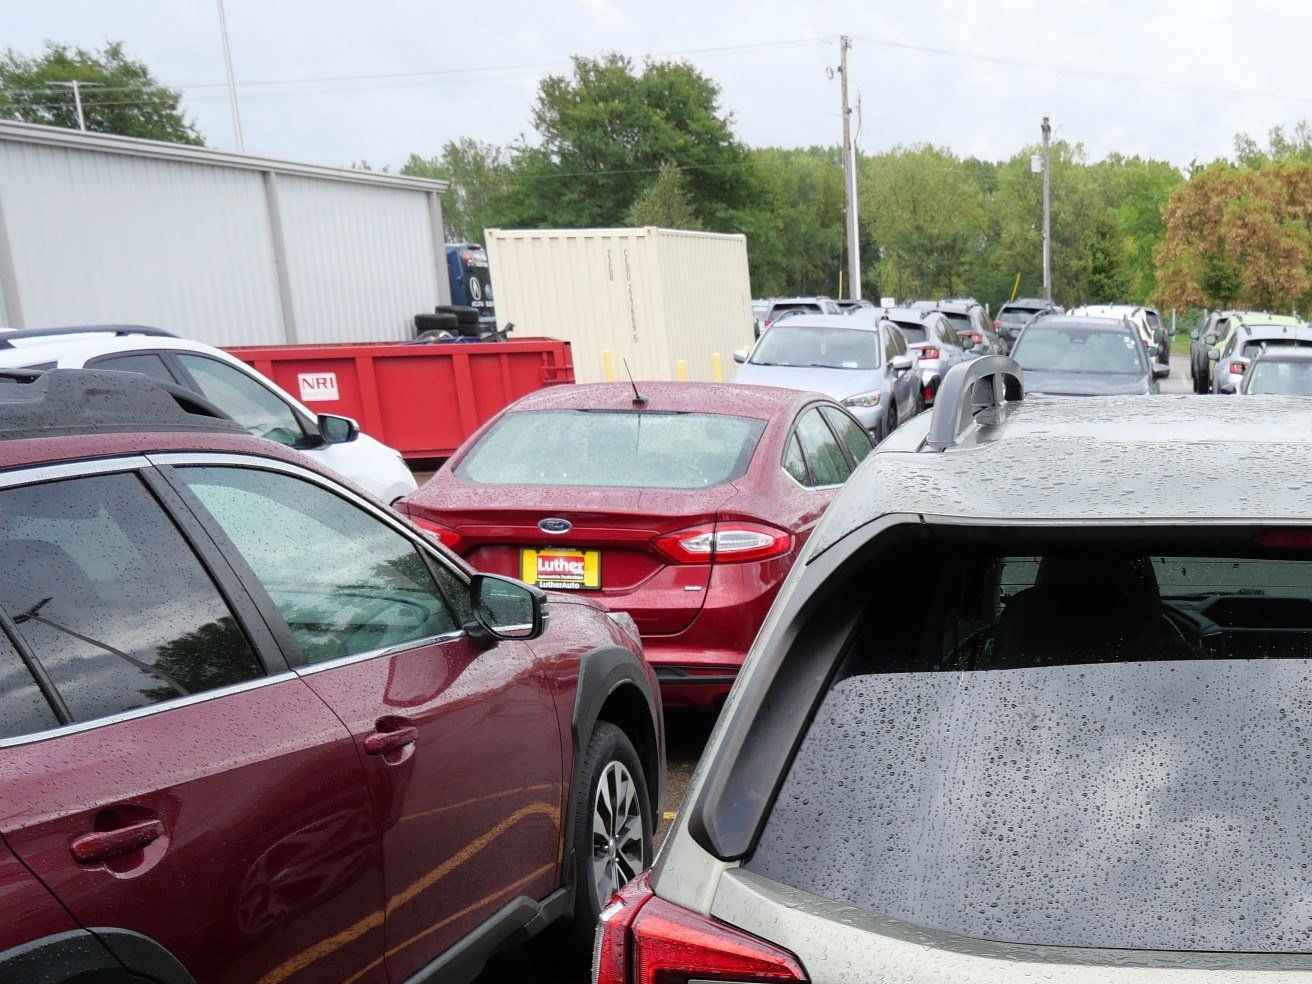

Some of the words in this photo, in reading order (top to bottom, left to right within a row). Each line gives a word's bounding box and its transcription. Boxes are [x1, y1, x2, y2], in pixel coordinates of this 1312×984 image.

[302, 377, 334, 389] NRI
[537, 557, 584, 572] Luther
[539, 581, 580, 589] LutherAuto
